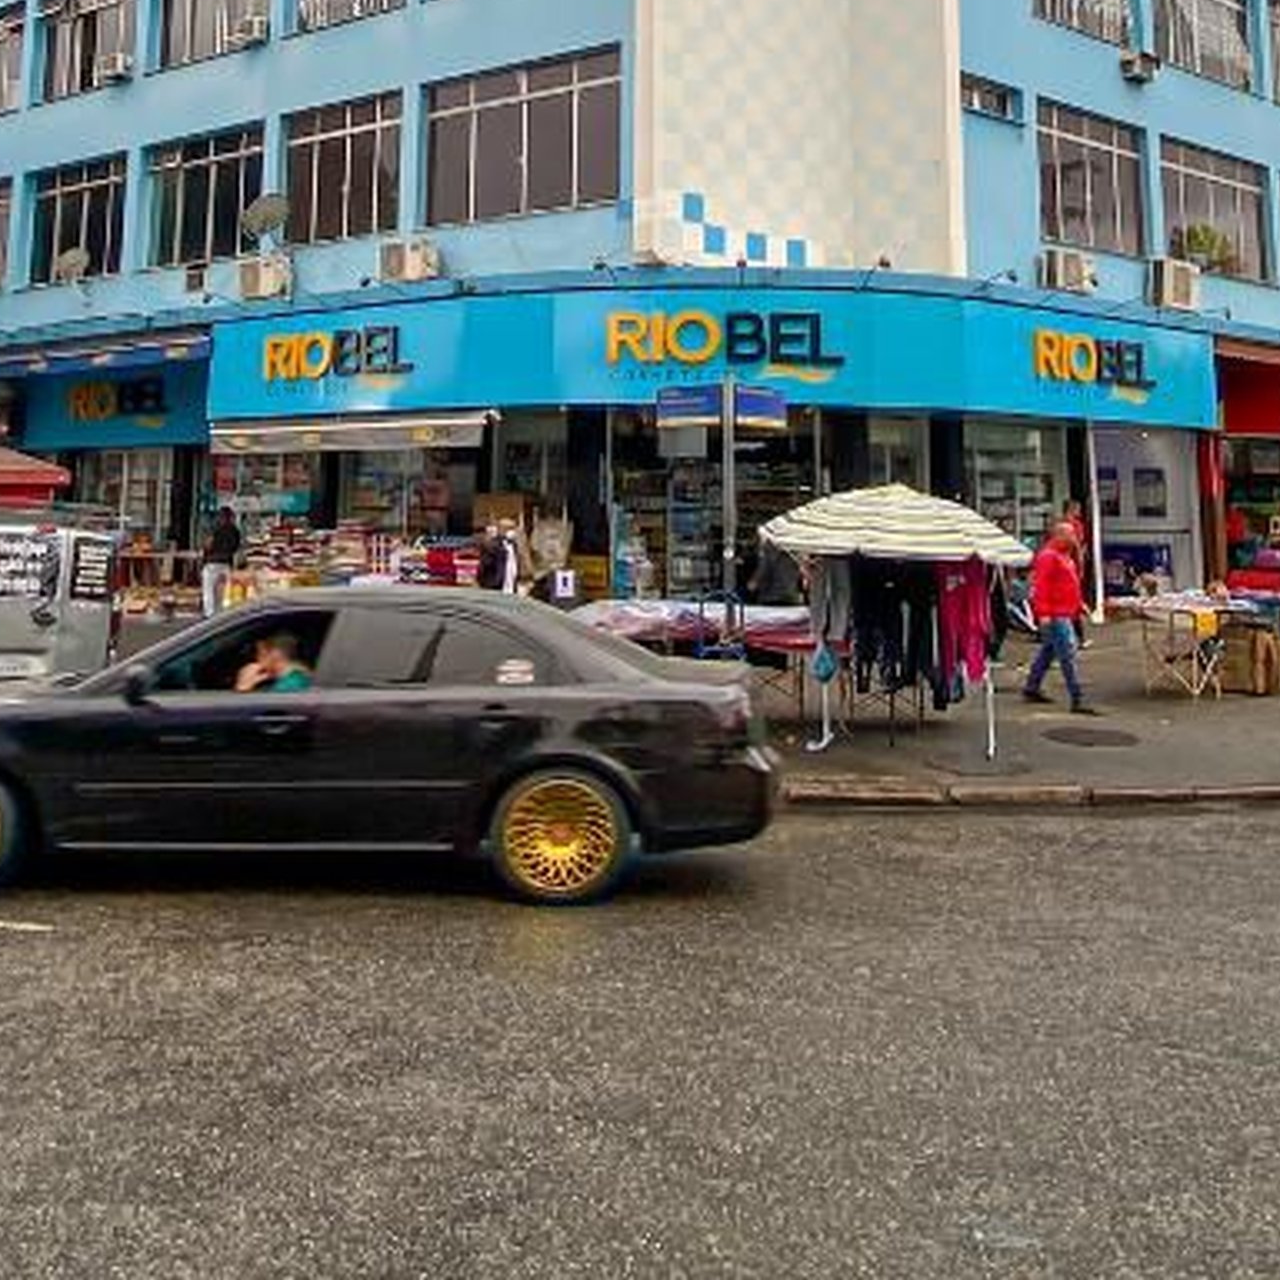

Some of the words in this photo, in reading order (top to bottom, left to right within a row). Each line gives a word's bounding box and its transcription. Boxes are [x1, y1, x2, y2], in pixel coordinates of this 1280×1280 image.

[263, 325, 416, 382] RIOBEL
[606, 310, 846, 366] RIOBEL
[1034, 330, 1157, 389] RIOBEL
